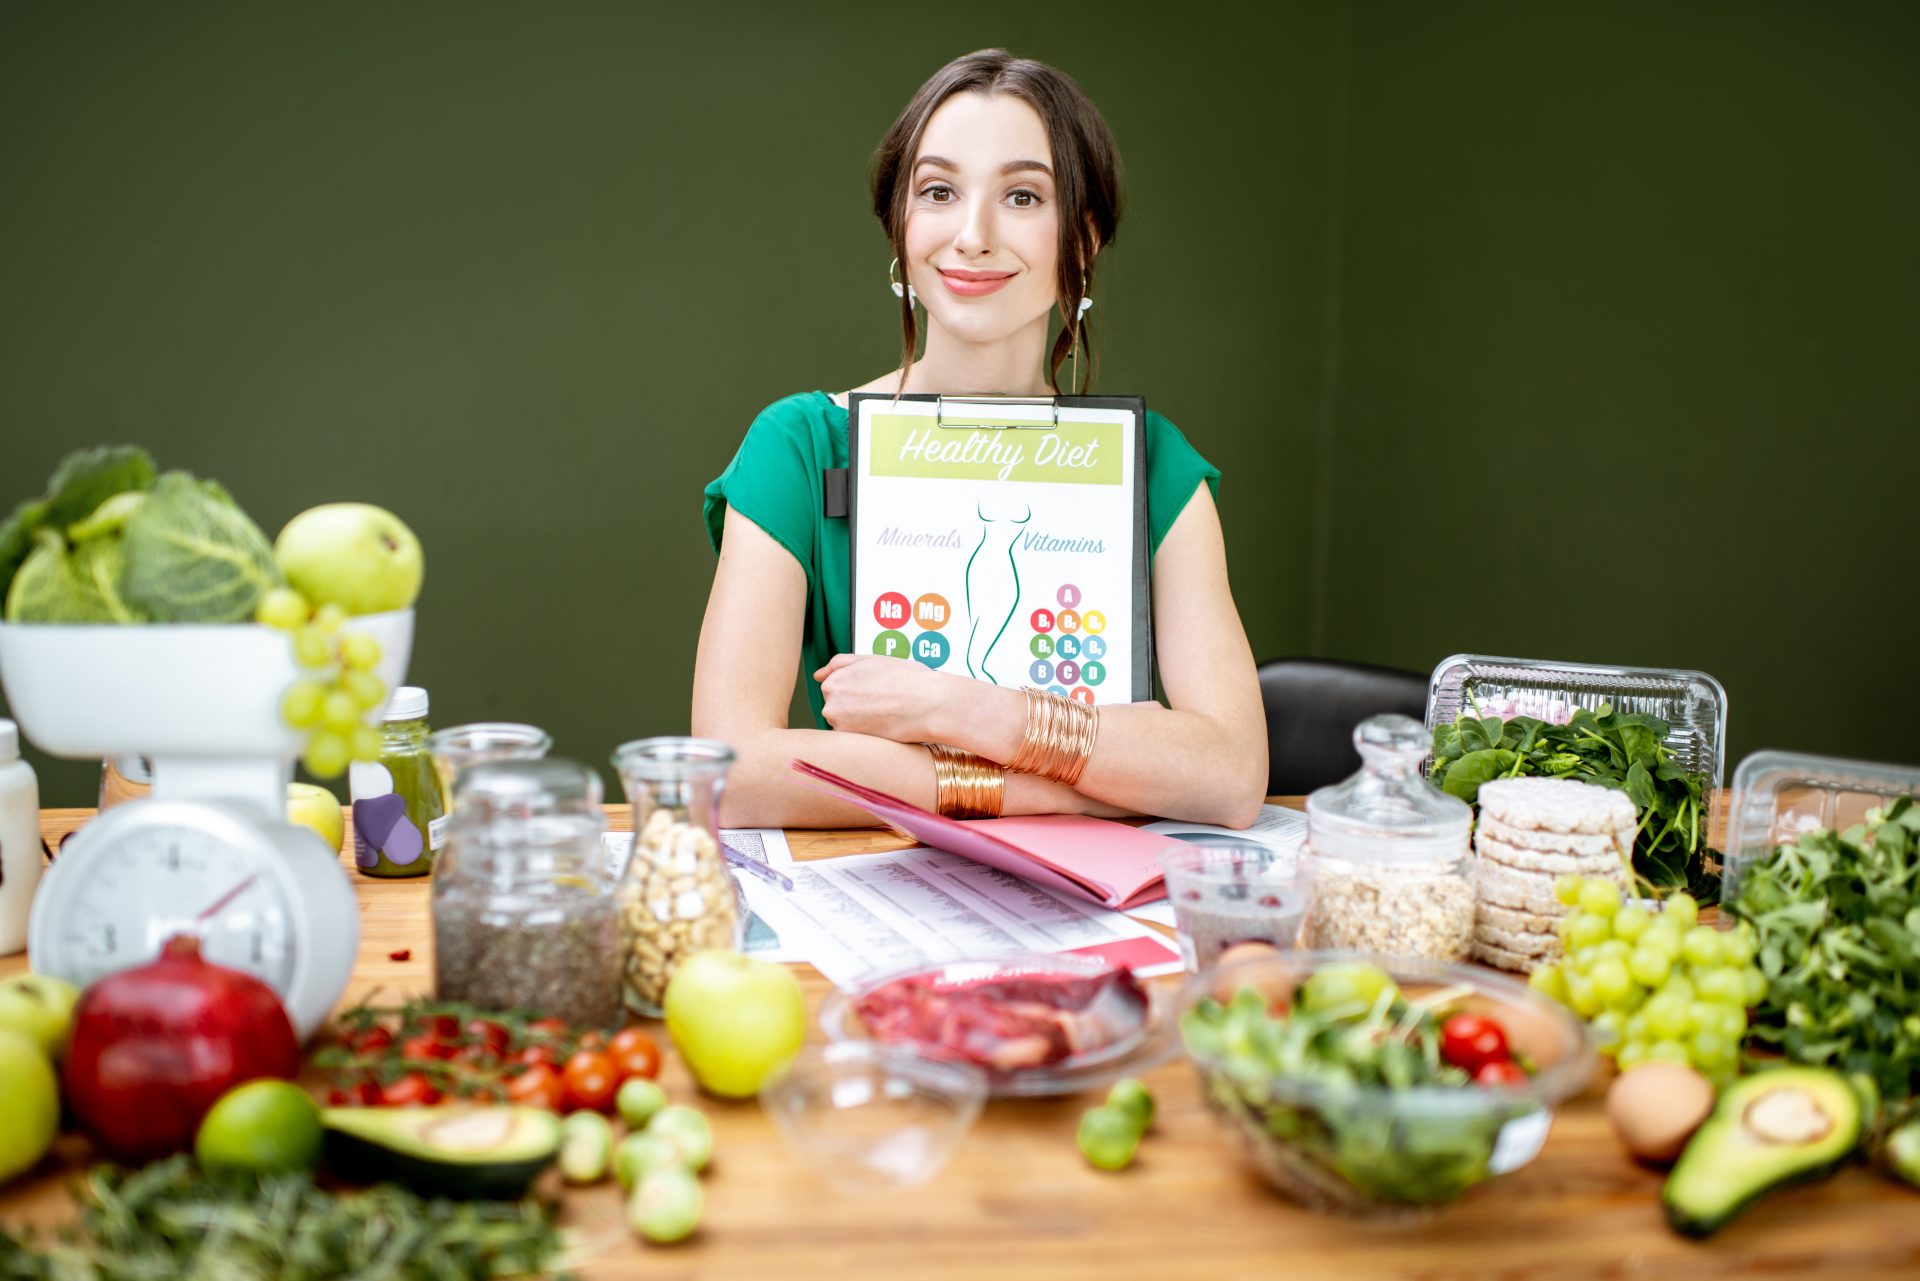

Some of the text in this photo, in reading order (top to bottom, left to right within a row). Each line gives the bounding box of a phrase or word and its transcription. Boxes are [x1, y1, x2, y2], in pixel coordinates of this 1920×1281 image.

[900, 428, 1100, 481] Healthy Diet
[877, 526, 963, 548] Minerals
[1023, 531, 1105, 553] Vitamins
[1063, 589, 1073, 602] A
[880, 600, 945, 622] Na Mg
[885, 638, 941, 658] P Ca
[1063, 665, 1073, 679] C
[1088, 666, 1098, 680] D
